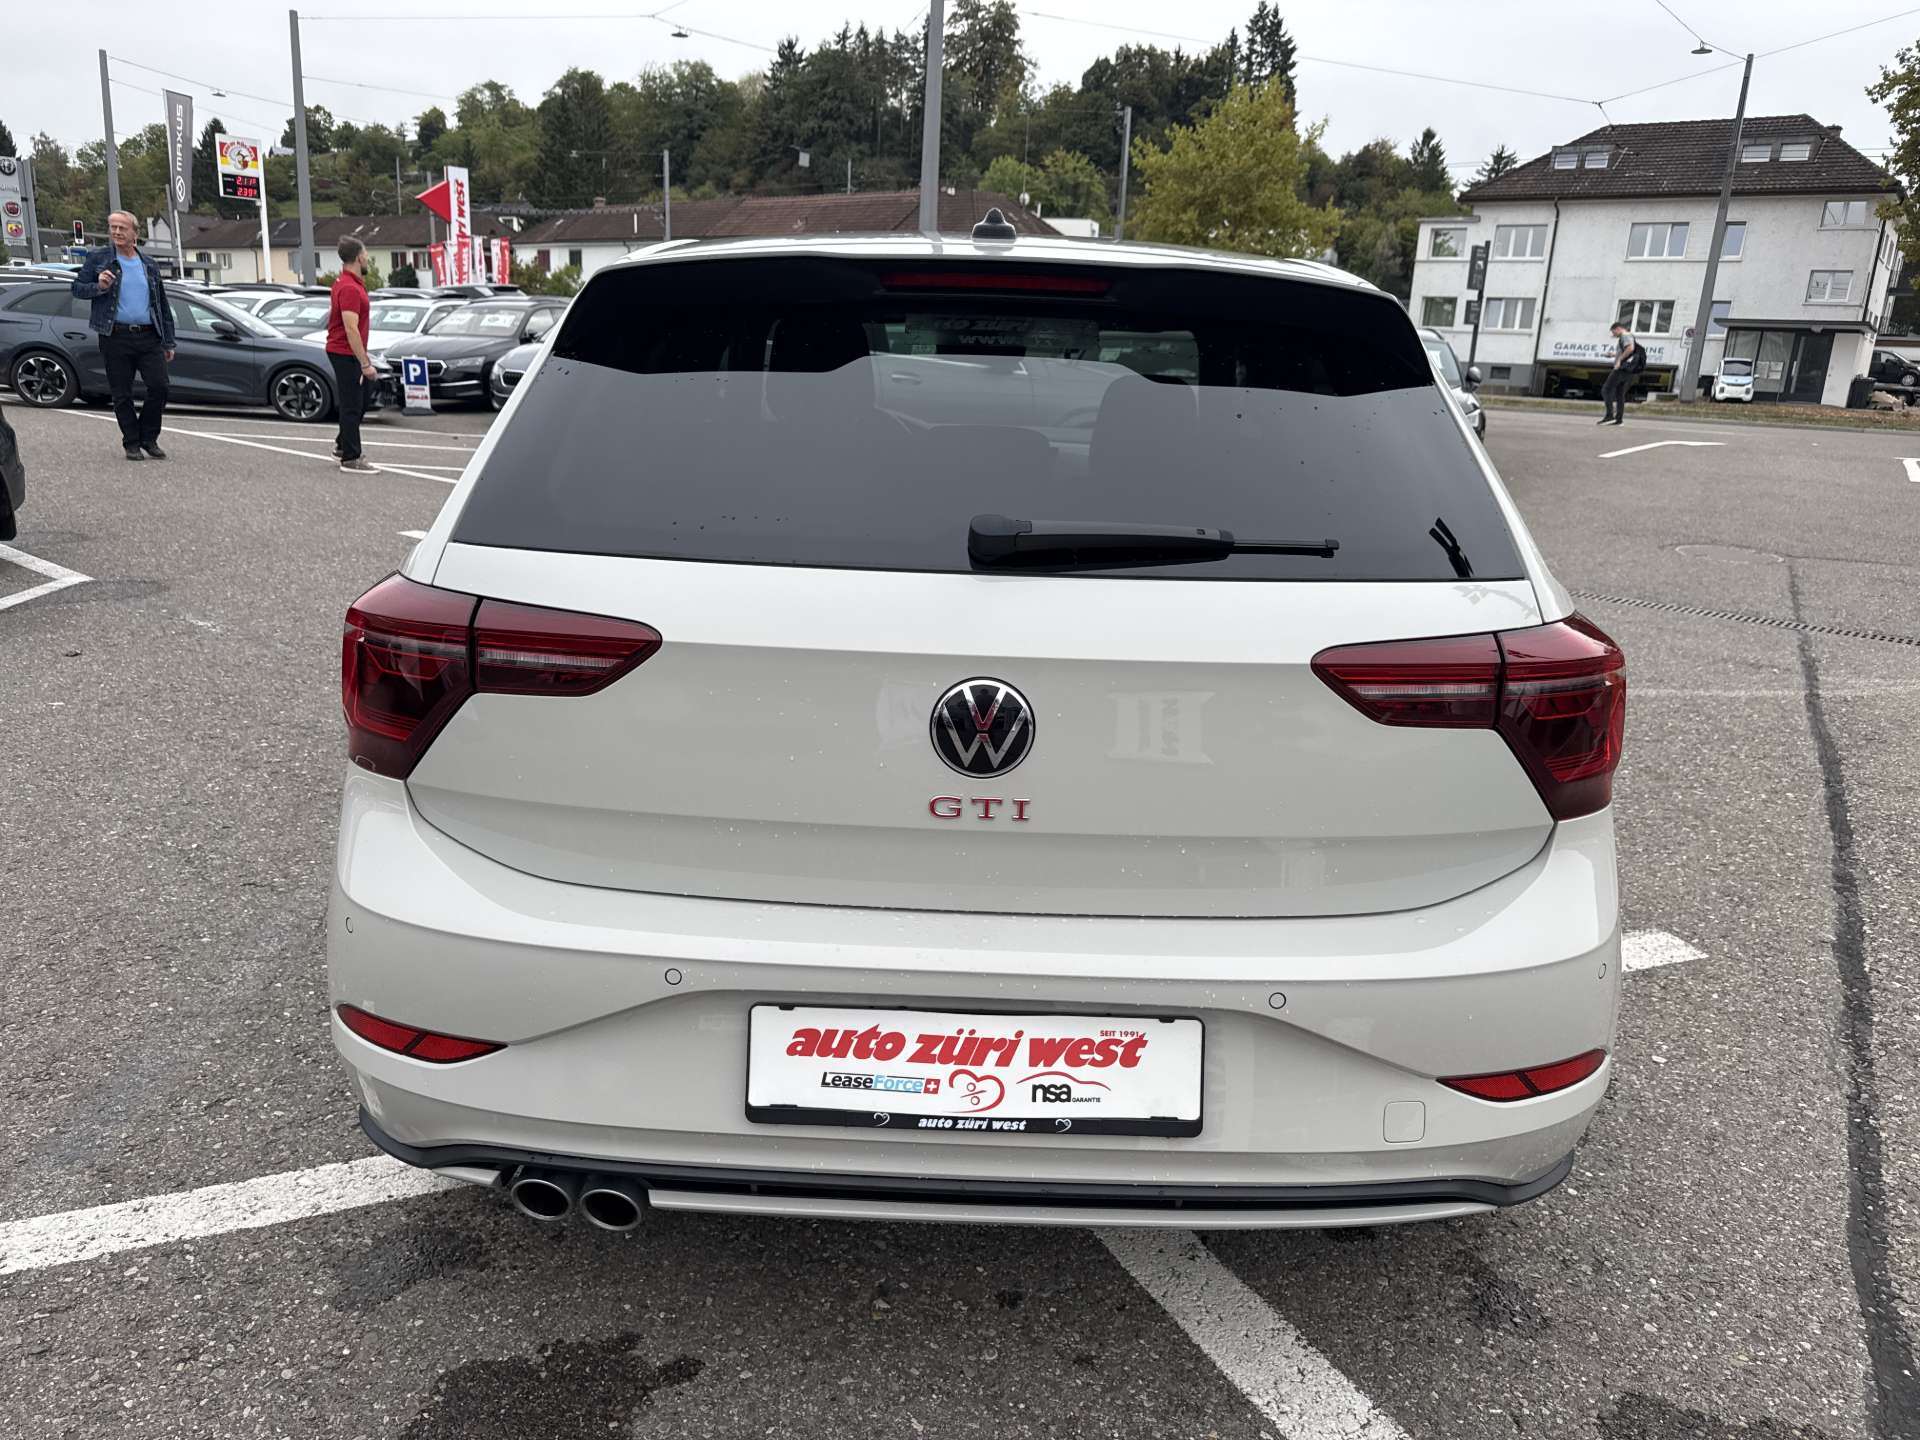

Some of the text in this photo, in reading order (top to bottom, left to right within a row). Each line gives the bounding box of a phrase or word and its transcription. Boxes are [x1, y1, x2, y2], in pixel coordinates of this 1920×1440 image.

[1554, 342, 1598, 352] GARAGE
[408, 363, 421, 382] P
[928, 795, 1031, 821] GTI
[1119, 1030, 1139, 1038] 1991
[786, 1023, 1149, 1068] auto züri west
[821, 1072, 923, 1092] LeaseForce
[1032, 1083, 1072, 1103] nsa
[918, 1117, 1027, 1132] auto züri west
